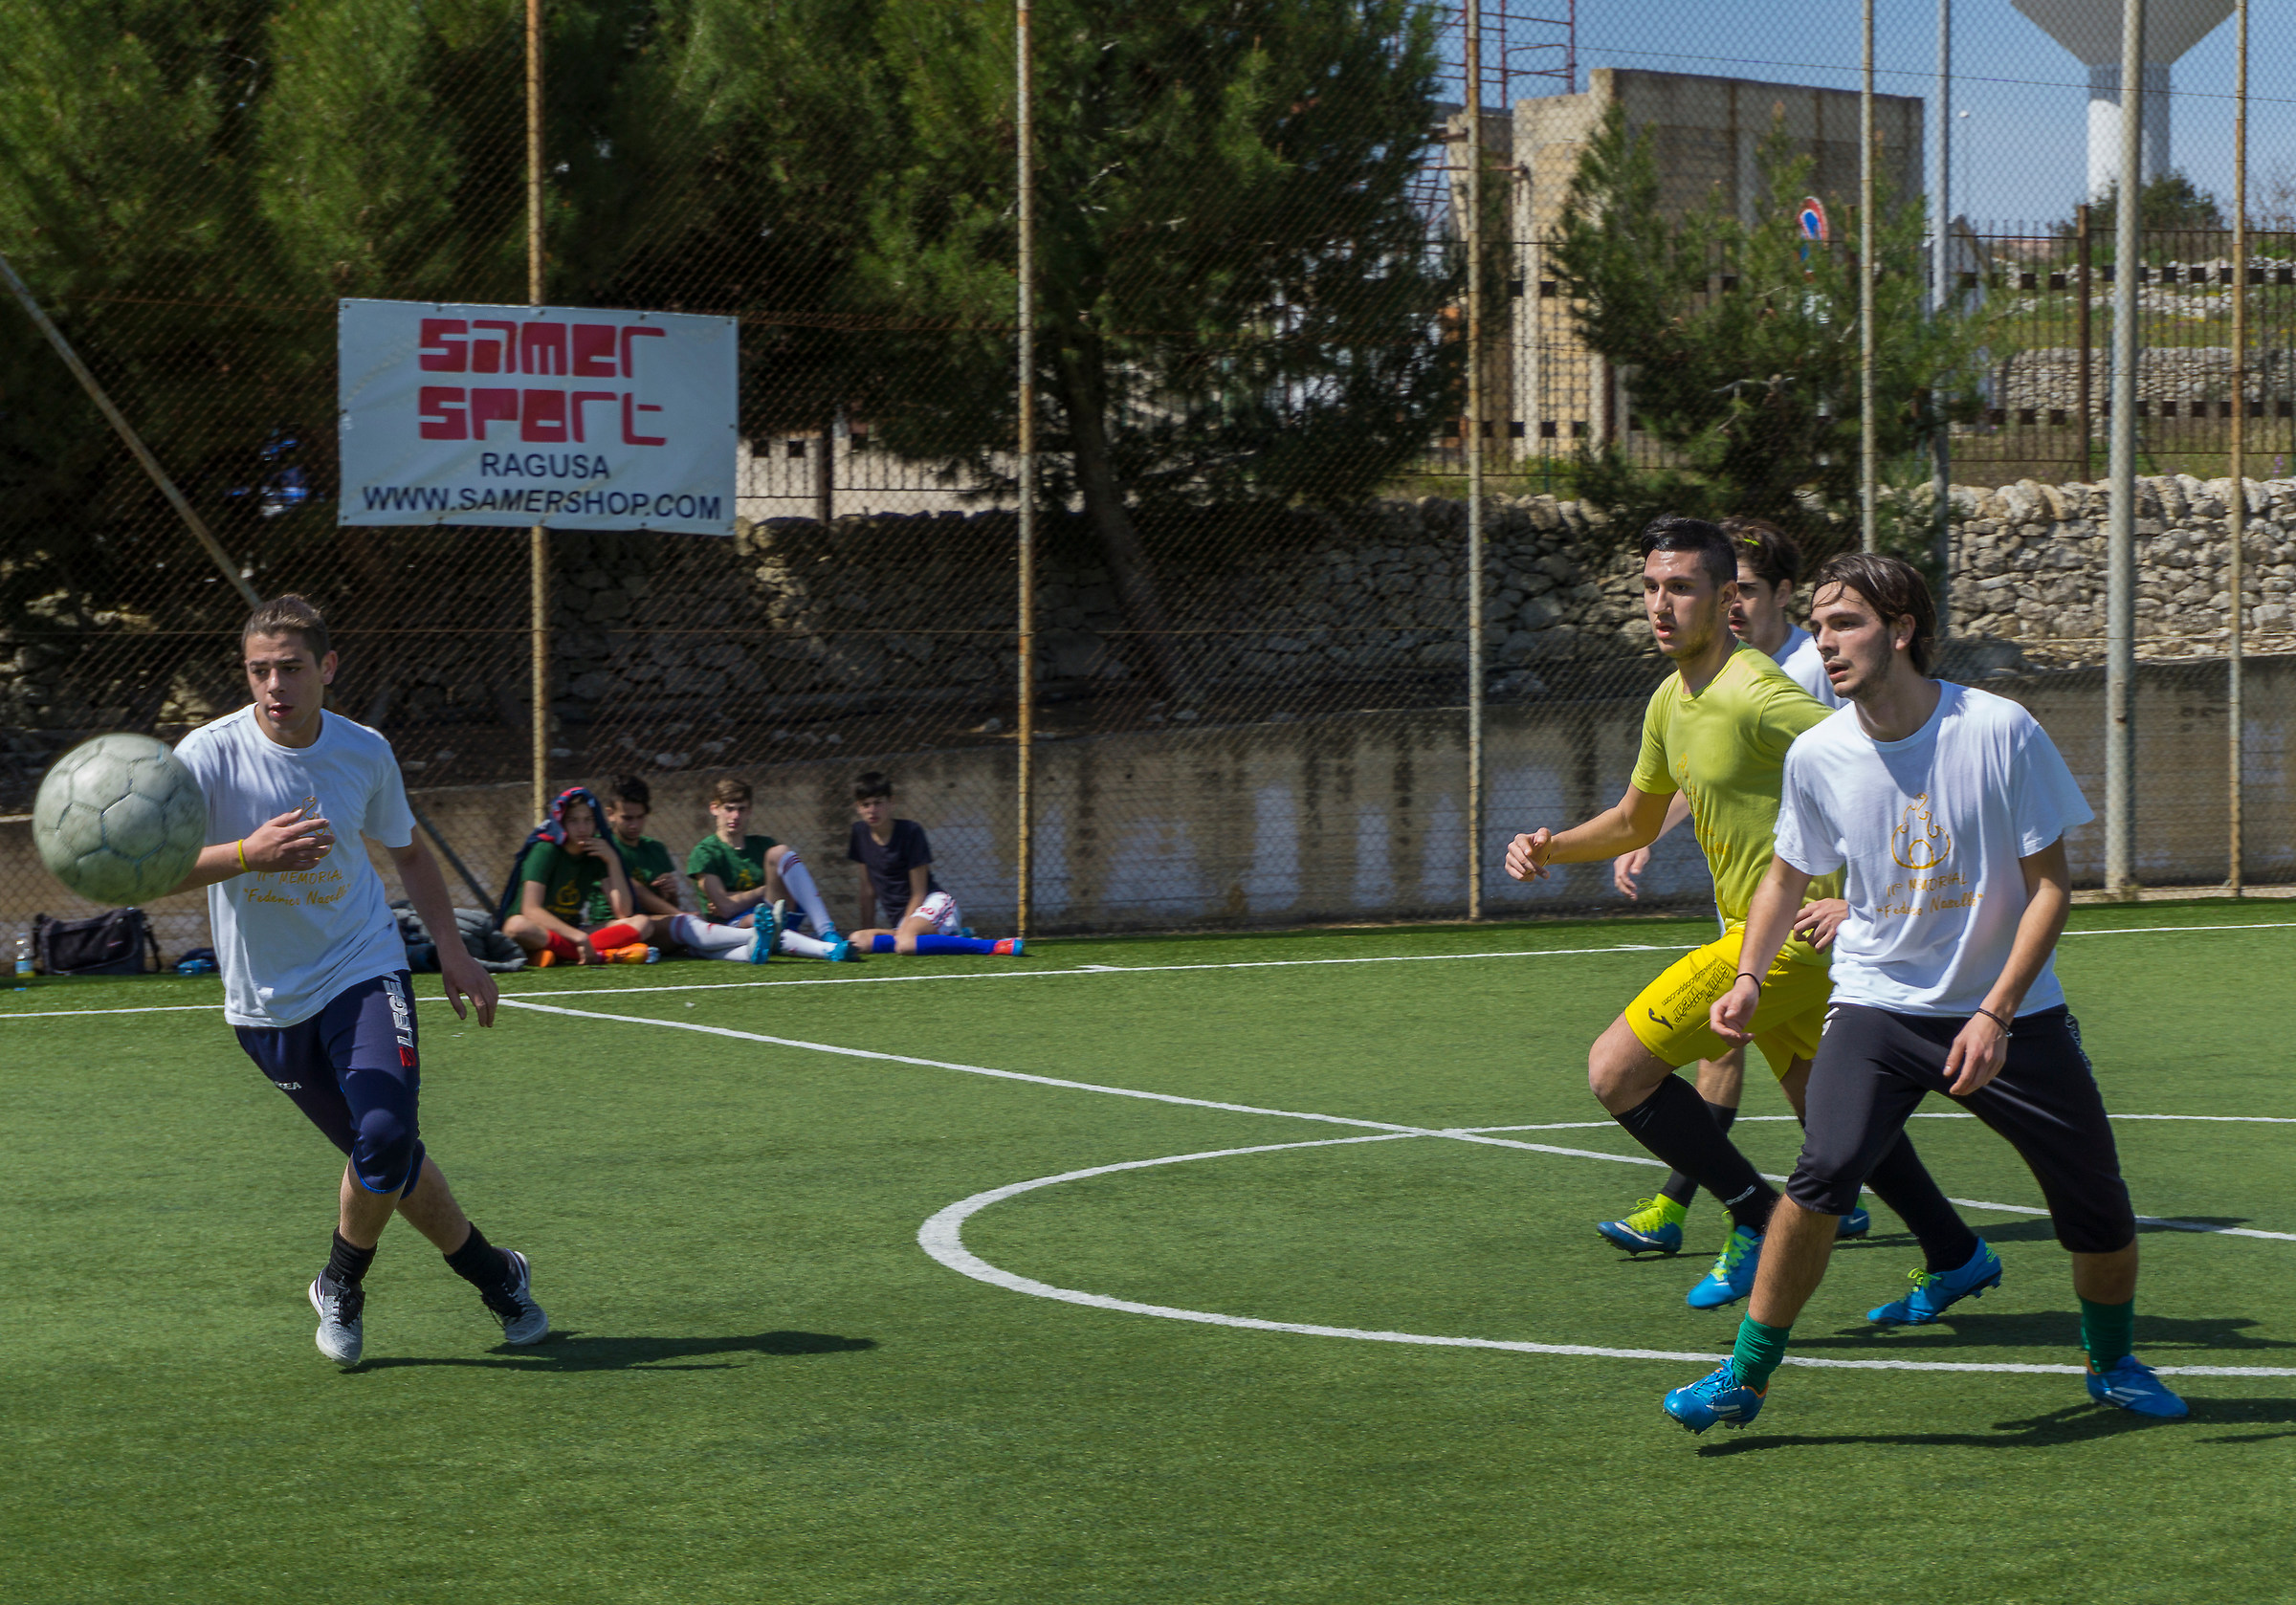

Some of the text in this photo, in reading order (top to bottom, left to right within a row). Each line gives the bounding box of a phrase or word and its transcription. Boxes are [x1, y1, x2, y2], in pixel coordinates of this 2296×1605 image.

[480, 451, 610, 479] RAGUSA
[363, 485, 721, 520] WWW.SAMERSHOP.COM
[278, 868, 344, 885] MEMORIAL
